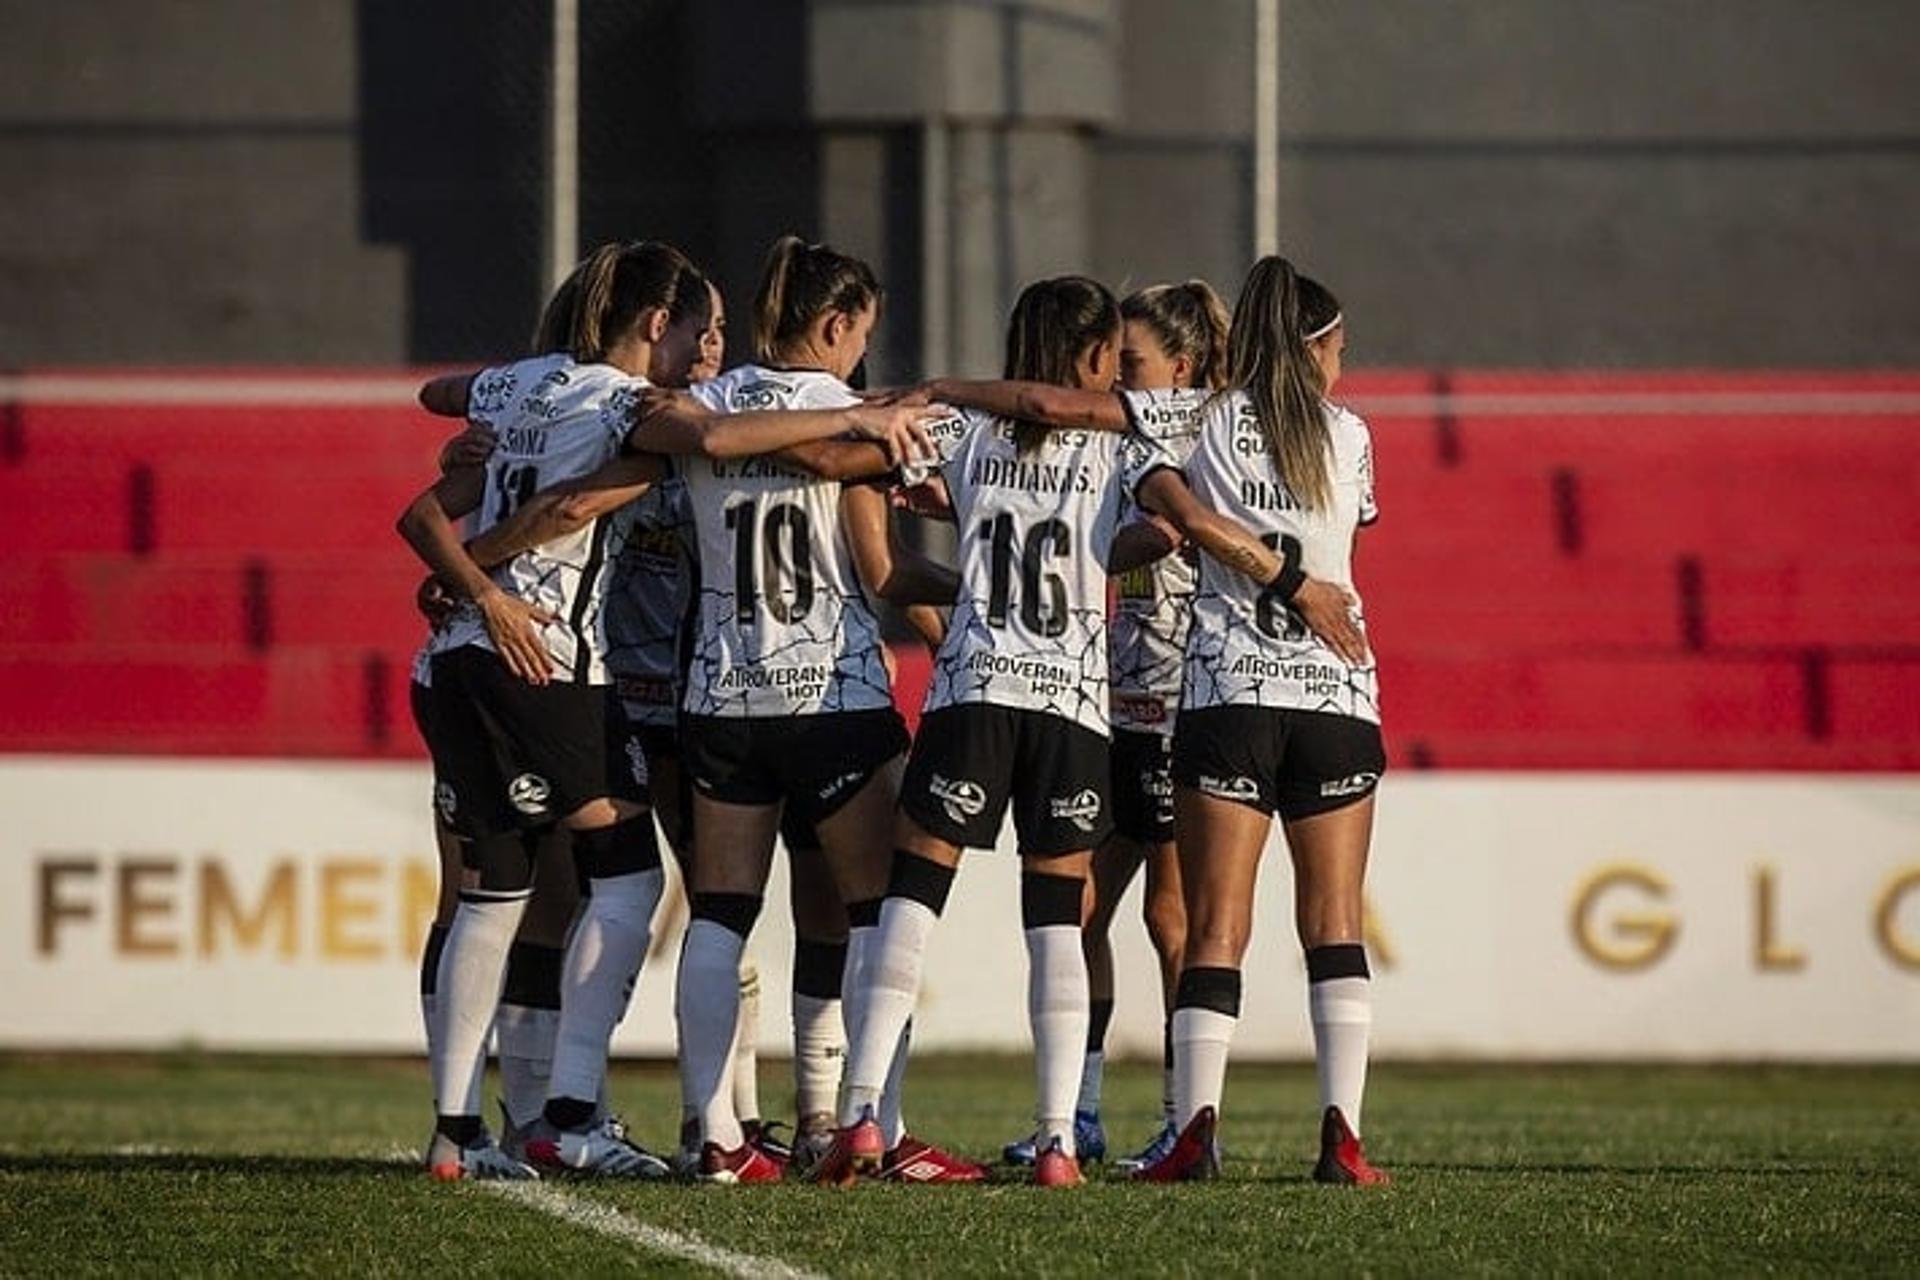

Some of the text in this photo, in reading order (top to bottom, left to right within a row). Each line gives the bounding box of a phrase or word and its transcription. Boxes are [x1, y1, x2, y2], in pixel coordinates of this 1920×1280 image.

[723, 498, 815, 627] 10
[979, 512, 1071, 639] 16
[720, 665, 826, 689] ATROVERAN
[1230, 653, 1342, 683] ATROVERAN
[786, 684, 825, 700] HOT
[1304, 681, 1341, 698] HOT
